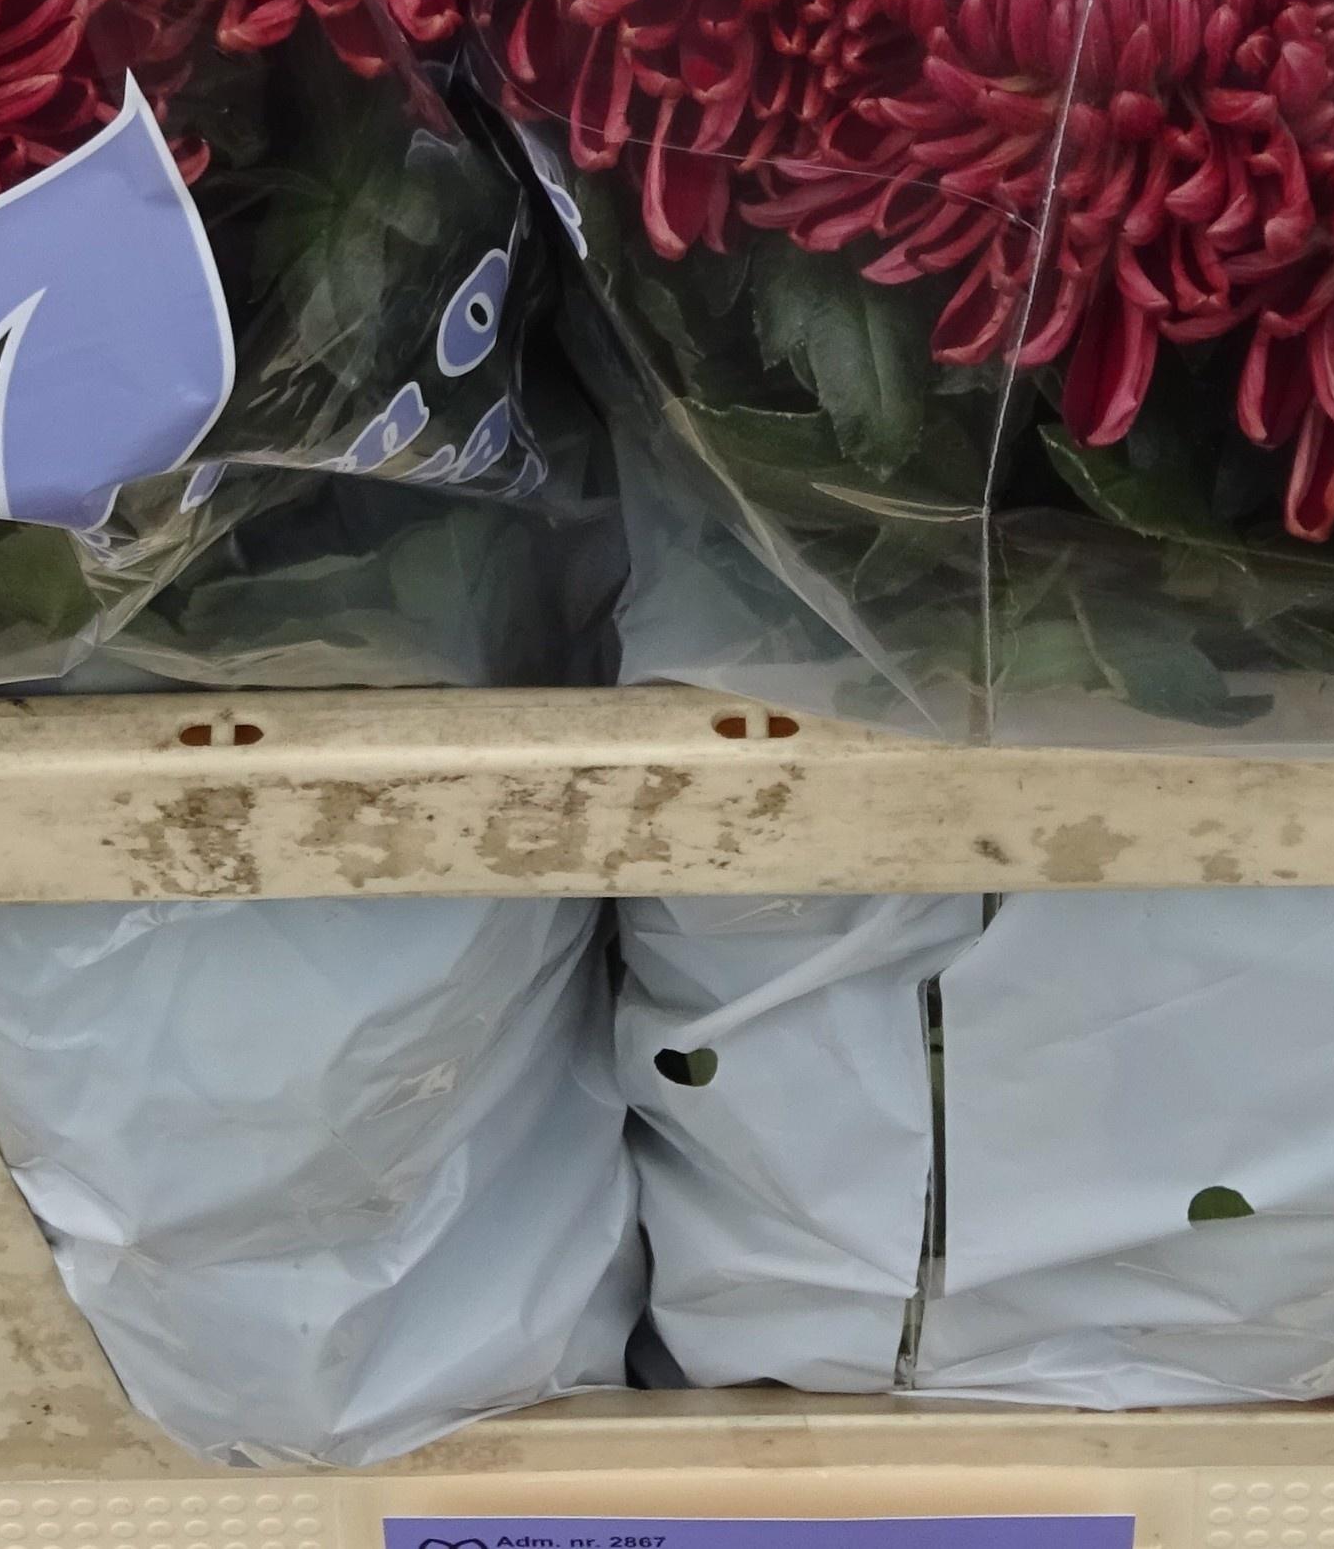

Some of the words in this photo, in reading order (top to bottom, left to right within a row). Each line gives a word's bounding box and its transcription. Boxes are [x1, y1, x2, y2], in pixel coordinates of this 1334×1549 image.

[496, 1535, 560, 1548] Adm.
[569, 1537, 600, 1548] nr.
[609, 1535, 666, 1548] 2867
